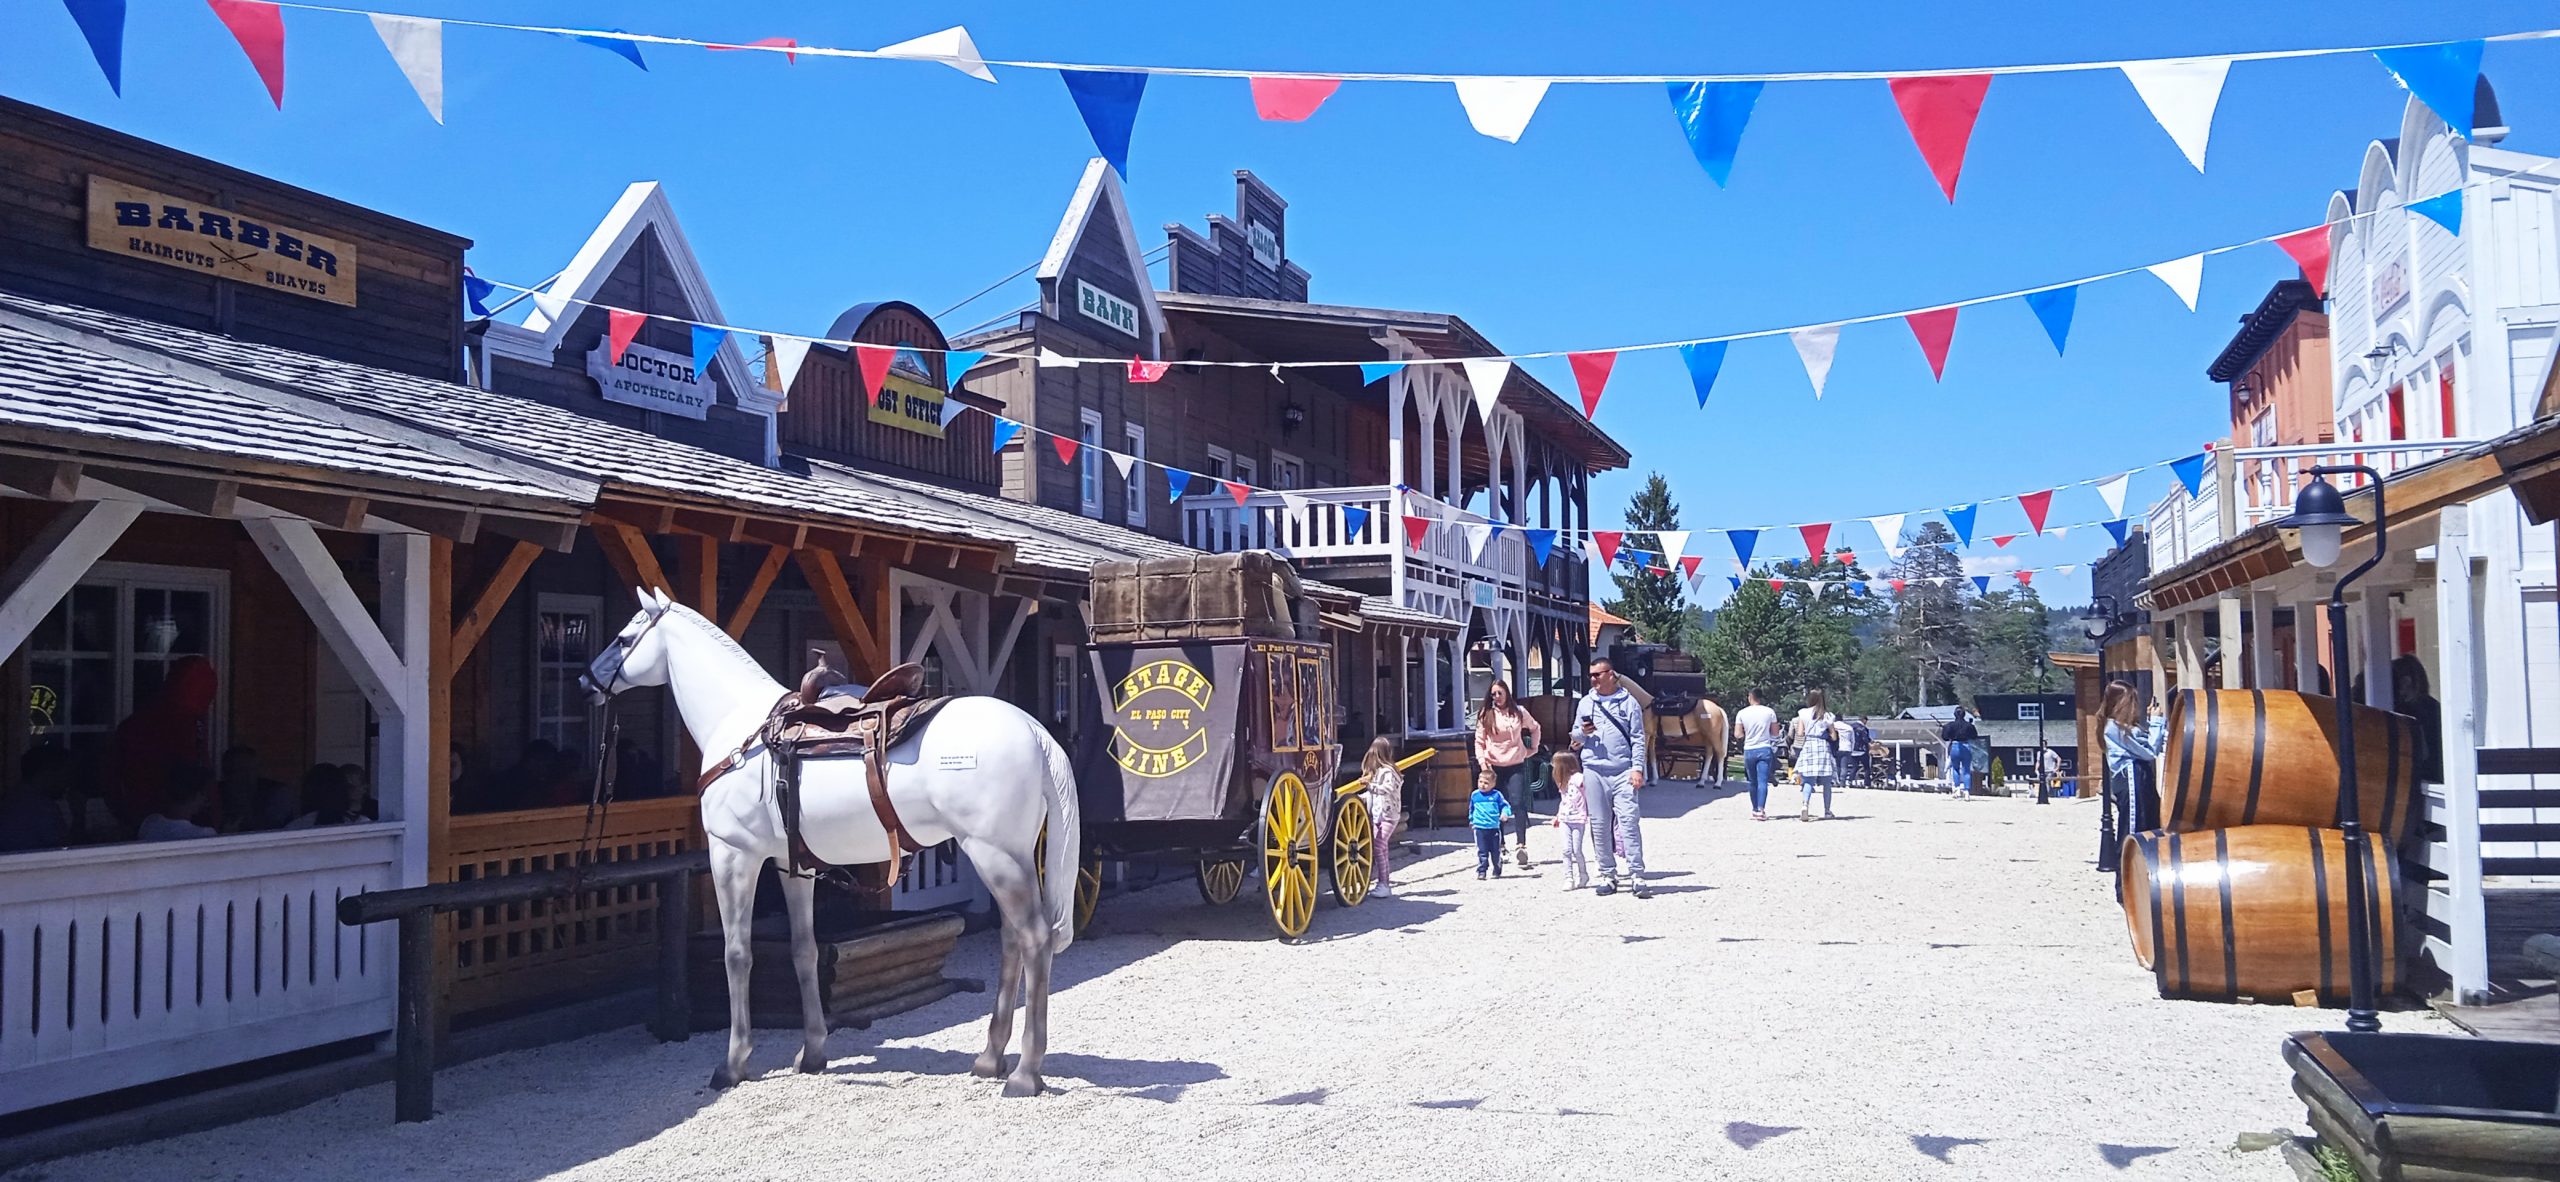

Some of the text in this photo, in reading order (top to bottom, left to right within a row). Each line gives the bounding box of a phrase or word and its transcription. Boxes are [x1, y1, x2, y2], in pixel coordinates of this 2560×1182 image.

[115, 202, 338, 277] BARBER
[129, 237, 215, 268] HAIRCUTS
[266, 271, 326, 295] SHAVES
[1082, 286, 1134, 332] BANK
[614, 379, 704, 408] APOTHECARY
[876, 388, 899, 414] OST
[1123, 664, 1205, 698] STAGE
[1130, 709, 1191, 720] EL PASO CITY
[1121, 747, 1187, 774] LINE
